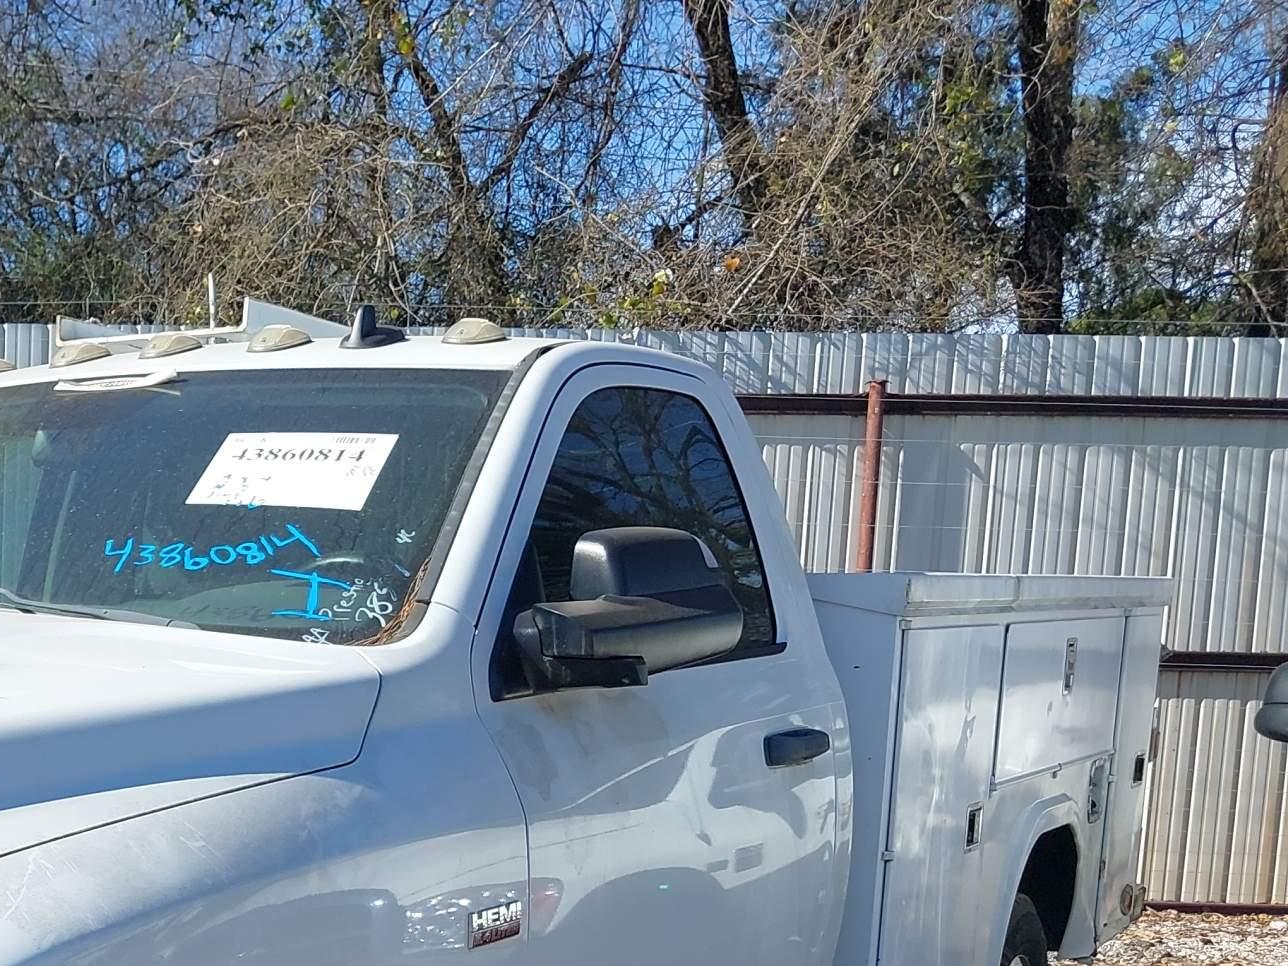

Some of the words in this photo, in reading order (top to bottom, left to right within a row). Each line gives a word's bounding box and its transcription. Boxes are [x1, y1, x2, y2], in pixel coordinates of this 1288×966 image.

[232, 448, 366, 462] 43860814
[105, 524, 320, 572] 43860814
[472, 901, 522, 930] HEMI
